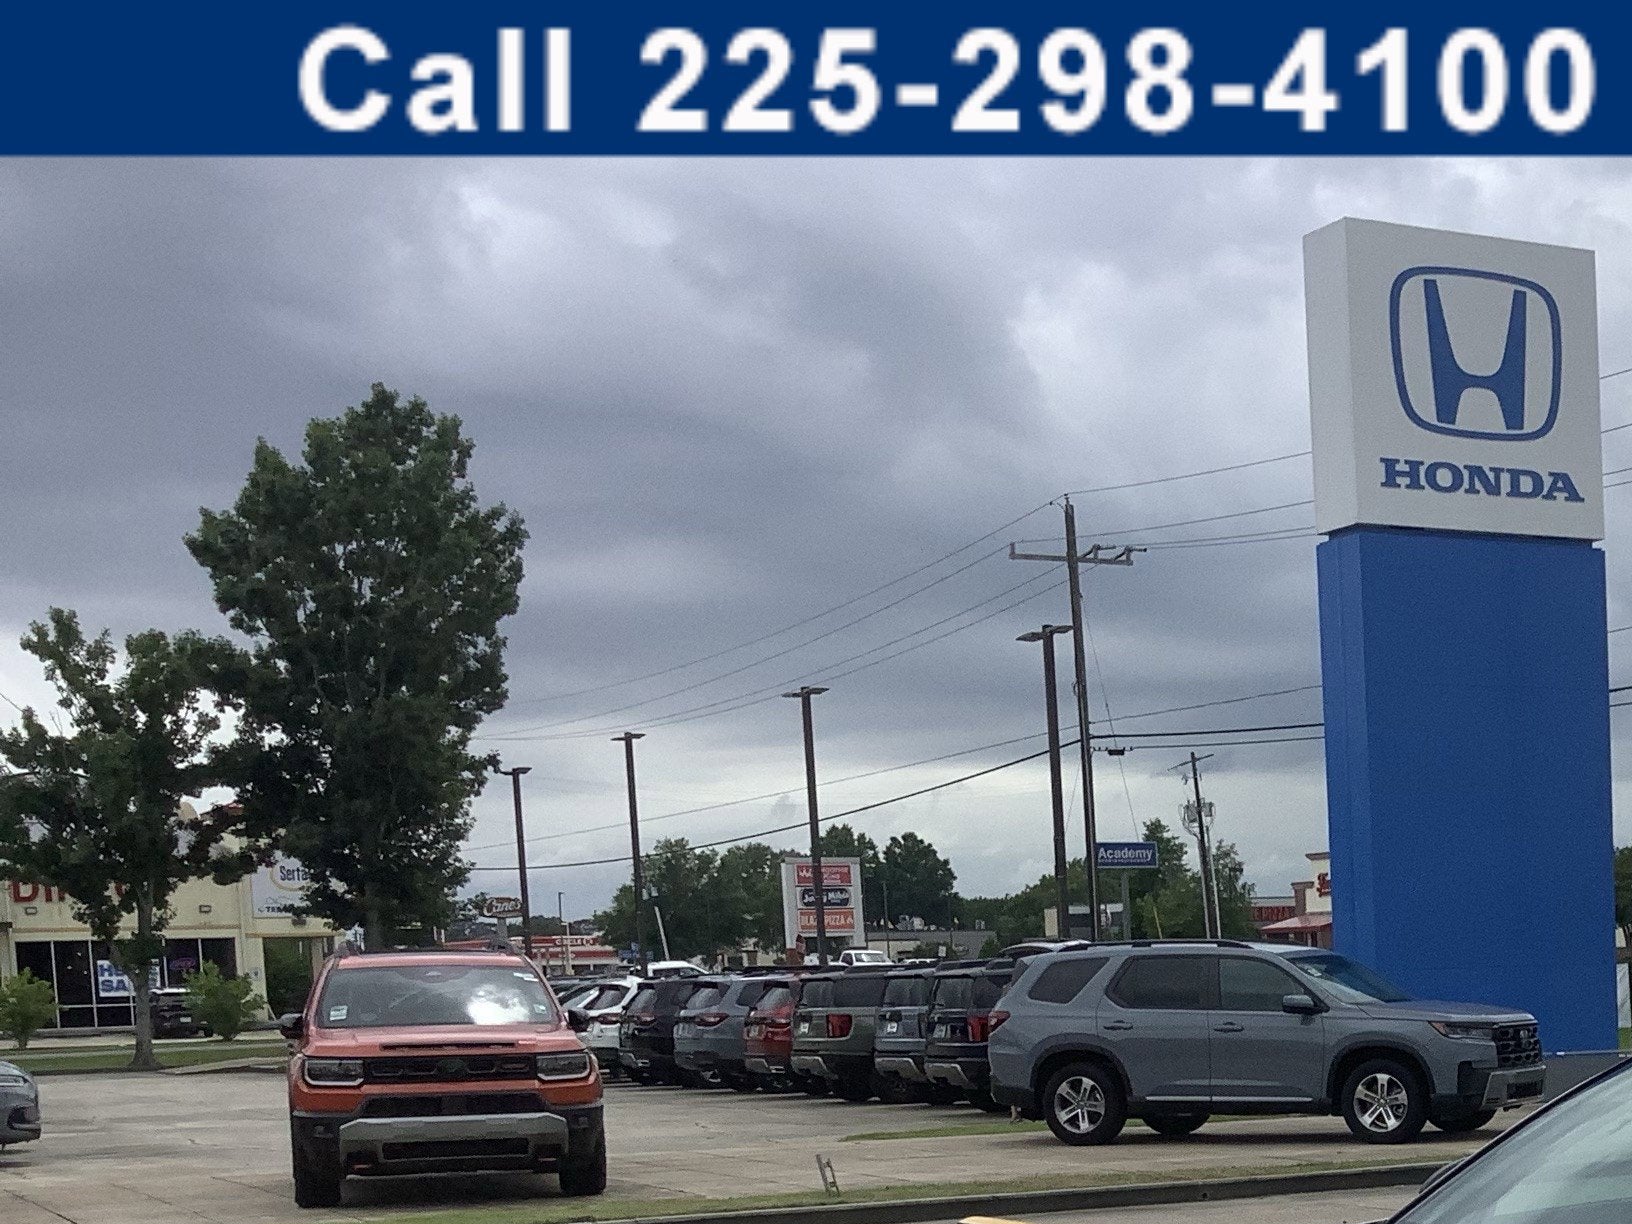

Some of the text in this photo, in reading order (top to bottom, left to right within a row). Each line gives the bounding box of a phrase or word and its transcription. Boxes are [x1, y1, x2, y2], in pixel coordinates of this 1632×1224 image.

[1379, 456, 1585, 503] HONDA
[1098, 847, 1153, 861] Academy
[279, 866, 309, 881] Serta
